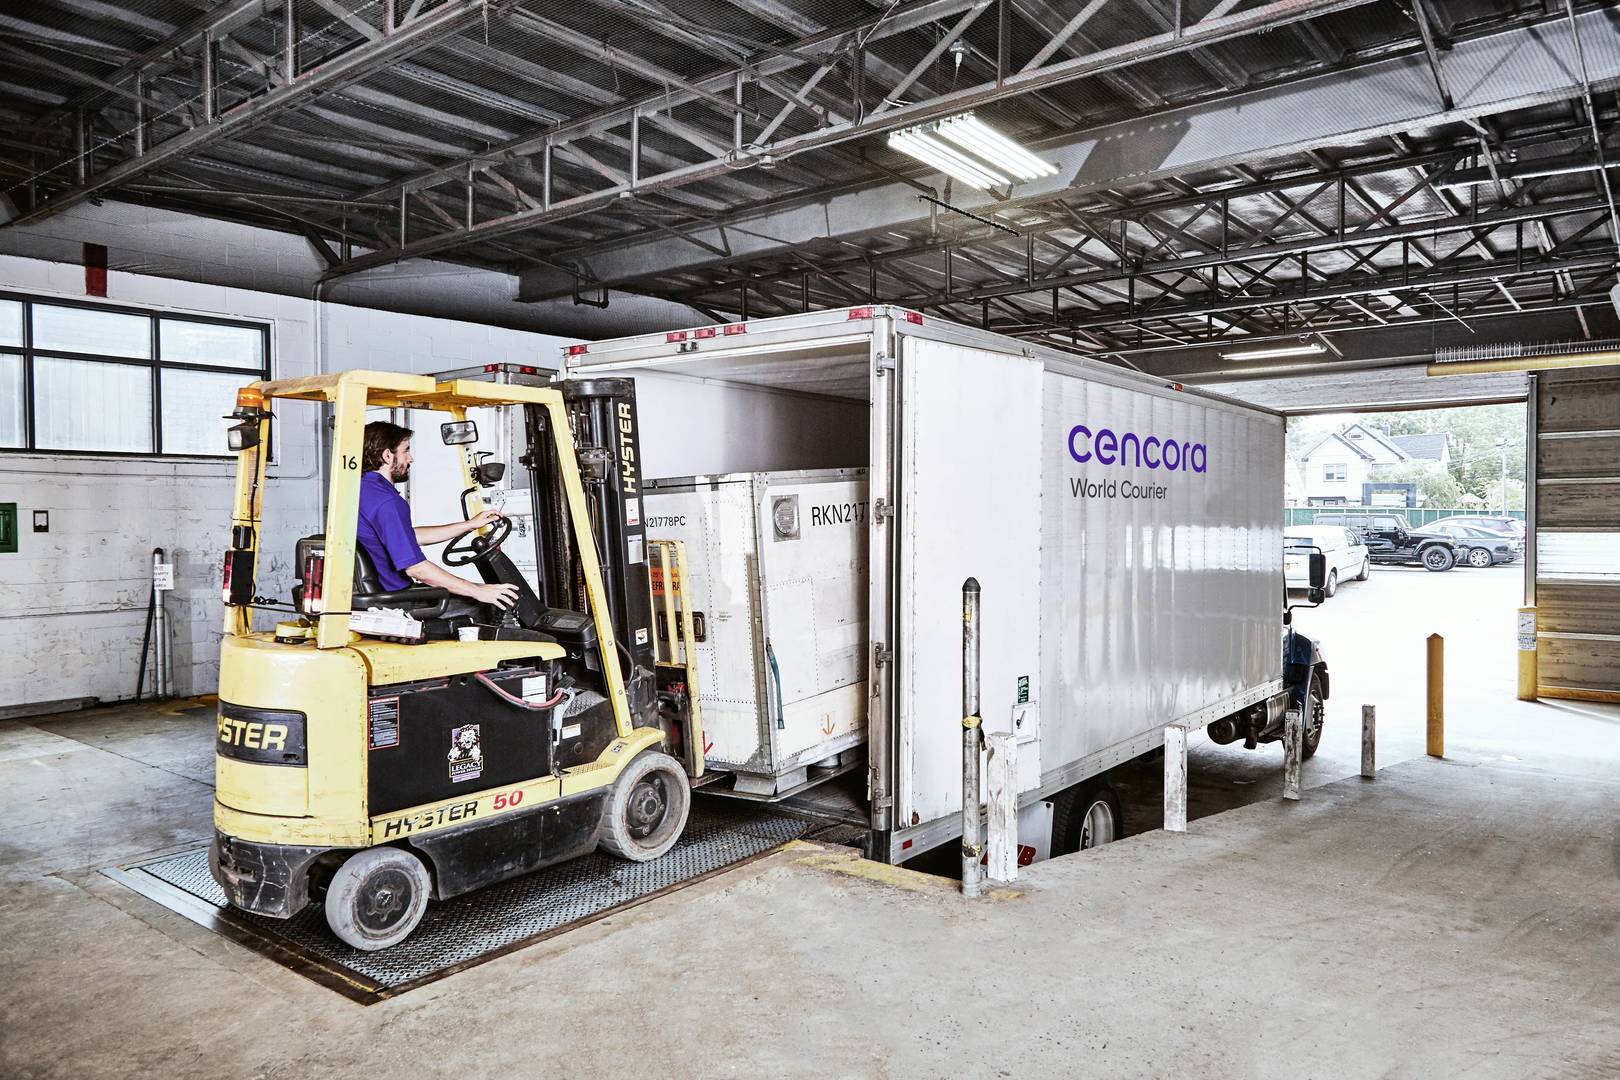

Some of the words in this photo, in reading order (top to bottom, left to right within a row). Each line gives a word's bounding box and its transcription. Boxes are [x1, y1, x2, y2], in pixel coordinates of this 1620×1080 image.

[342, 455, 358, 470] 16
[618, 402, 636, 493] HYSTER
[1068, 425, 1207, 473] cencora
[1070, 477, 1116, 498] World
[1120, 480, 1167, 500] Courier
[451, 761, 481, 772] LEGACY
[384, 800, 478, 838] HYSTER
[493, 790, 524, 811] 50
